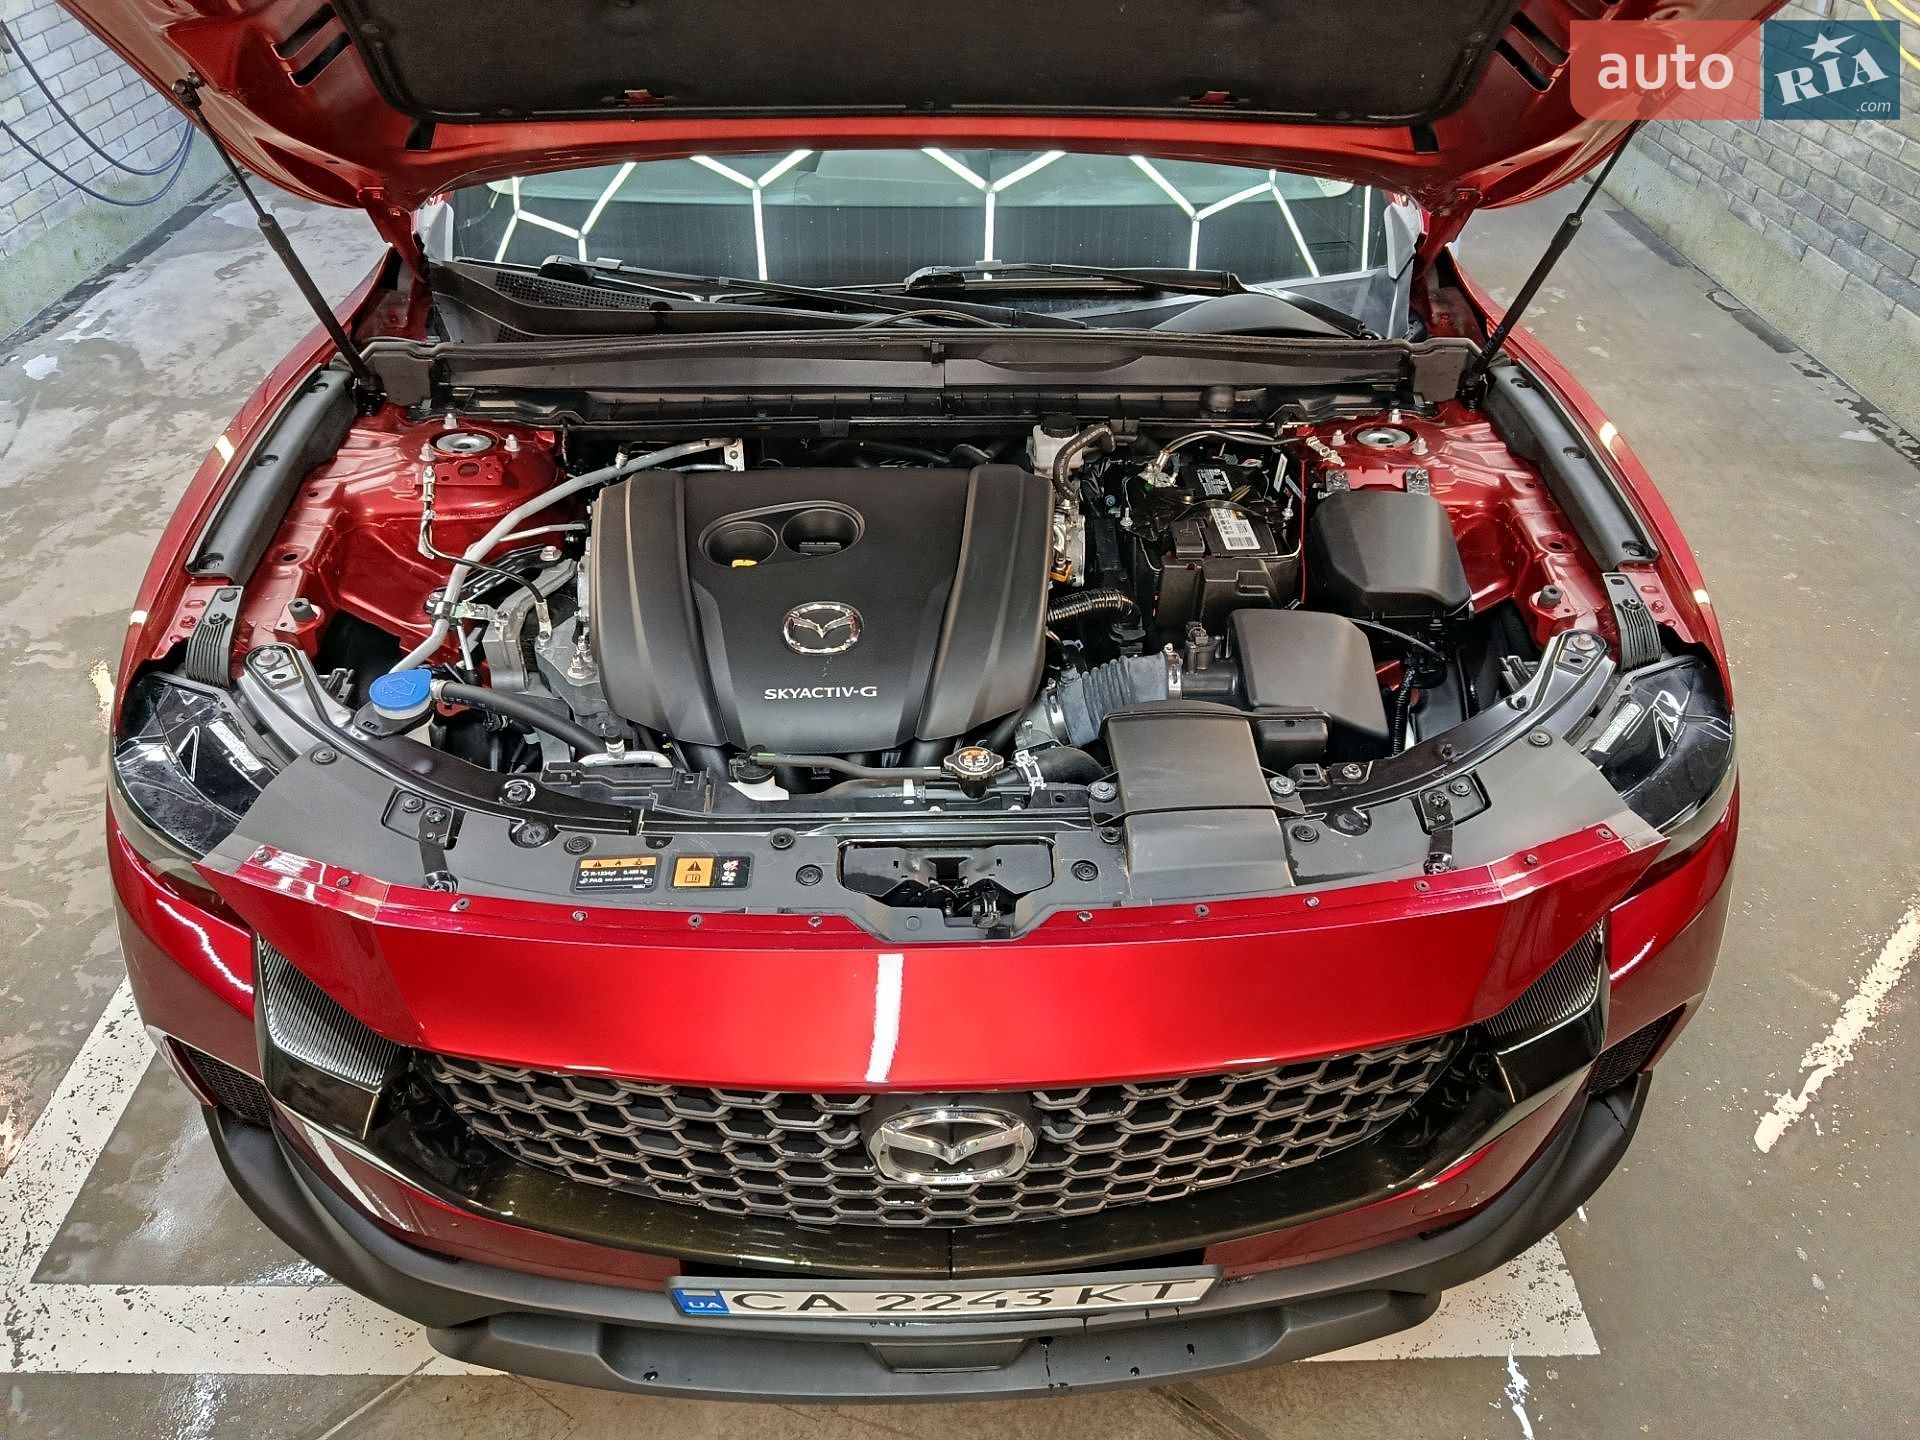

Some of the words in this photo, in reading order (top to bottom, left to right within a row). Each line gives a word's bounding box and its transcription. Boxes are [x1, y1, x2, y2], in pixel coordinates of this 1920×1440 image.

[763, 685, 878, 700] SKYACTIV-G
[732, 1292, 849, 1312] CA
[875, 1288, 1055, 1312] 2243
[1076, 1280, 1197, 1305] KT
[688, 1301, 722, 1310] UA
